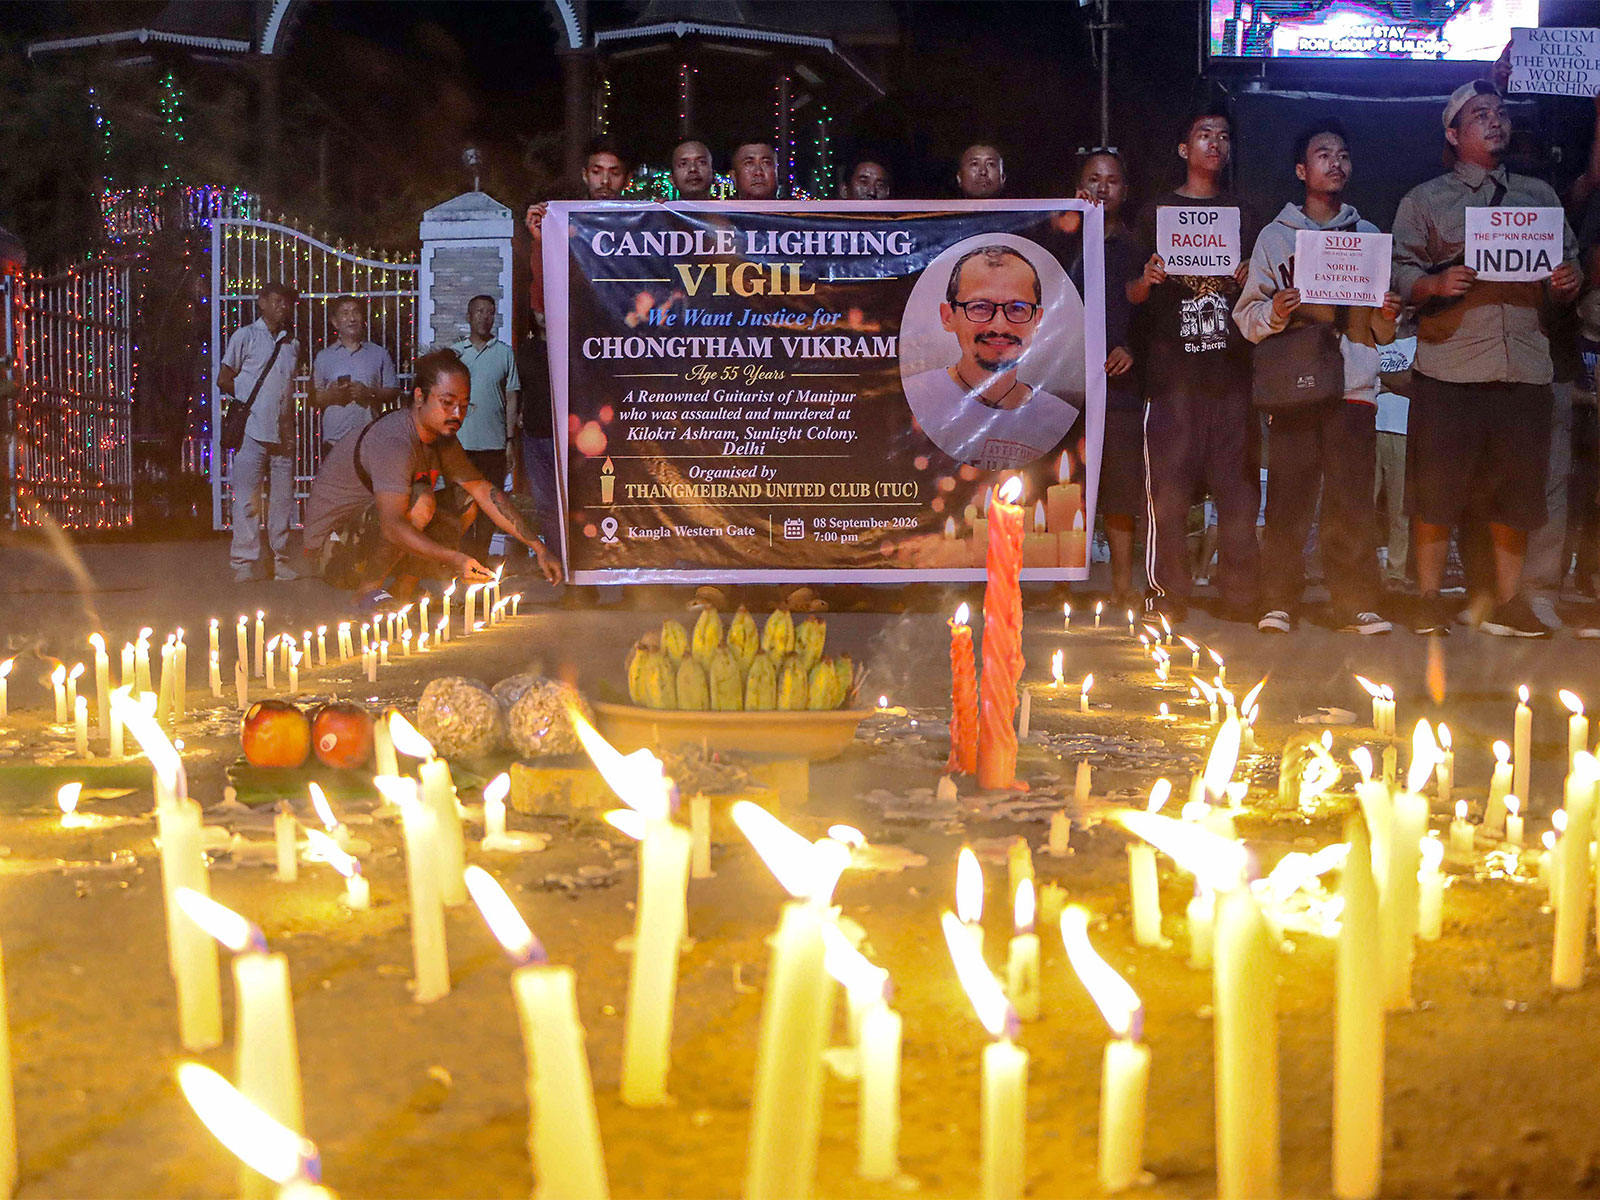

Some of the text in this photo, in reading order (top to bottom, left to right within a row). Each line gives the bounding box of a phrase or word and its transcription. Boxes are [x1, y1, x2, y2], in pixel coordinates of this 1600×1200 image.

[1373, 25, 1407, 39] STAY
[1529, 30, 1594, 43] RACISM
[1331, 38, 1377, 52] GROUP
[1378, 39, 1389, 52] 2
[1389, 38, 1450, 54] BUILDING
[1540, 43, 1586, 57] KILLS.
[1514, 55, 1600, 71] THE WHOLE
[1529, 69, 1588, 83] WORLD
[1509, 80, 1600, 96] IS WATCHING
[1178, 211, 1219, 225] STOP
[1490, 211, 1538, 227] STOP
[592, 230, 912, 256] CANDLE LIGHTING
[1171, 233, 1227, 248] RACIAL
[1325, 235, 1362, 249] STOP
[1474, 232, 1490, 241] THE
[1521, 232, 1554, 241] RACISM
[1167, 255, 1231, 267] ASSAULTS
[1326, 262, 1359, 272] NORTH-
[1476, 249, 1552, 273] INDIA
[674, 262, 816, 298] VIGIL
[1314, 273, 1370, 284] EASTERNERS
[1306, 289, 1377, 301] MAINLAND INDIA
[648, 308, 842, 329] We Want Justice for
[581, 336, 898, 359] CHONGTHAM VIKRAM
[684, 364, 786, 383] Age 55 Years
[622, 389, 857, 407] A Renowned Guitarist of Manipur
[619, 406, 852, 421] who was assaulted and murdered at
[626, 427, 859, 443] Kilokri Ashram, Sunlight Colony.
[721, 441, 766, 456] Delhi
[688, 465, 777, 483] Organised by
[625, 480, 919, 499] THANGMEIBAND UNITED CLUB (TUC)
[813, 517, 918, 531] 08 September 2026
[627, 525, 756, 540] Kangla Western Gate
[813, 532, 859, 544] 7:00 pm
